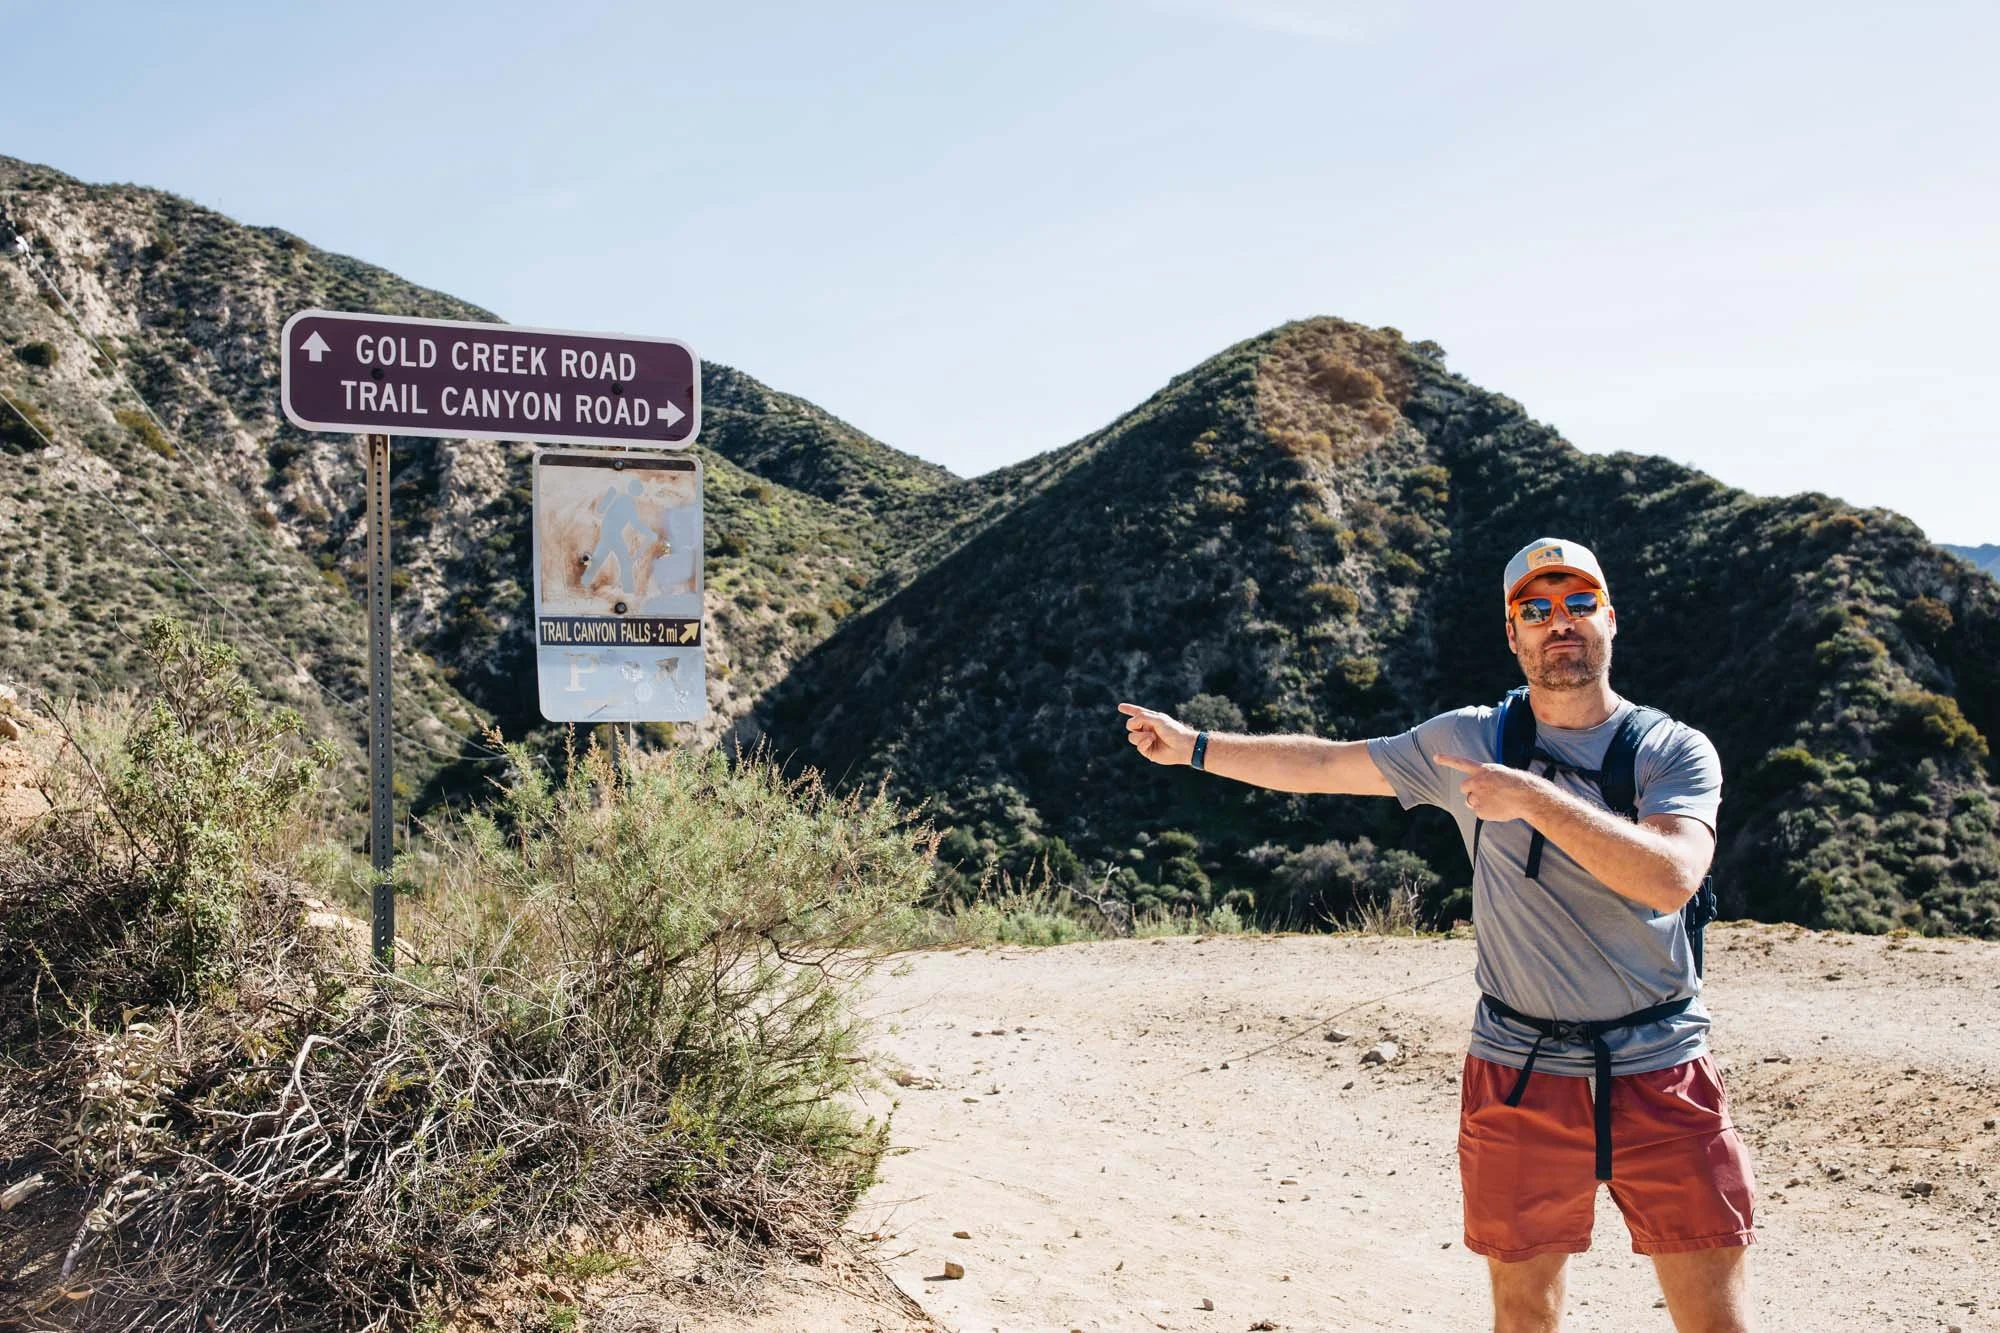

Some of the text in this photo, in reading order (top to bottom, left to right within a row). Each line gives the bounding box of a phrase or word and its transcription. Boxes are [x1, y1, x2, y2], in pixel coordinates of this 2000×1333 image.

[356, 334, 636, 382] GOLD CREEK ROAD
[340, 379, 650, 427] TRAIL CANYON ROAD
[541, 621, 572, 642] TRAIL
[573, 622, 616, 642] CANYON
[620, 623, 651, 643] FALLS
[658, 623, 665, 643] 2
[666, 624, 678, 643] mi
